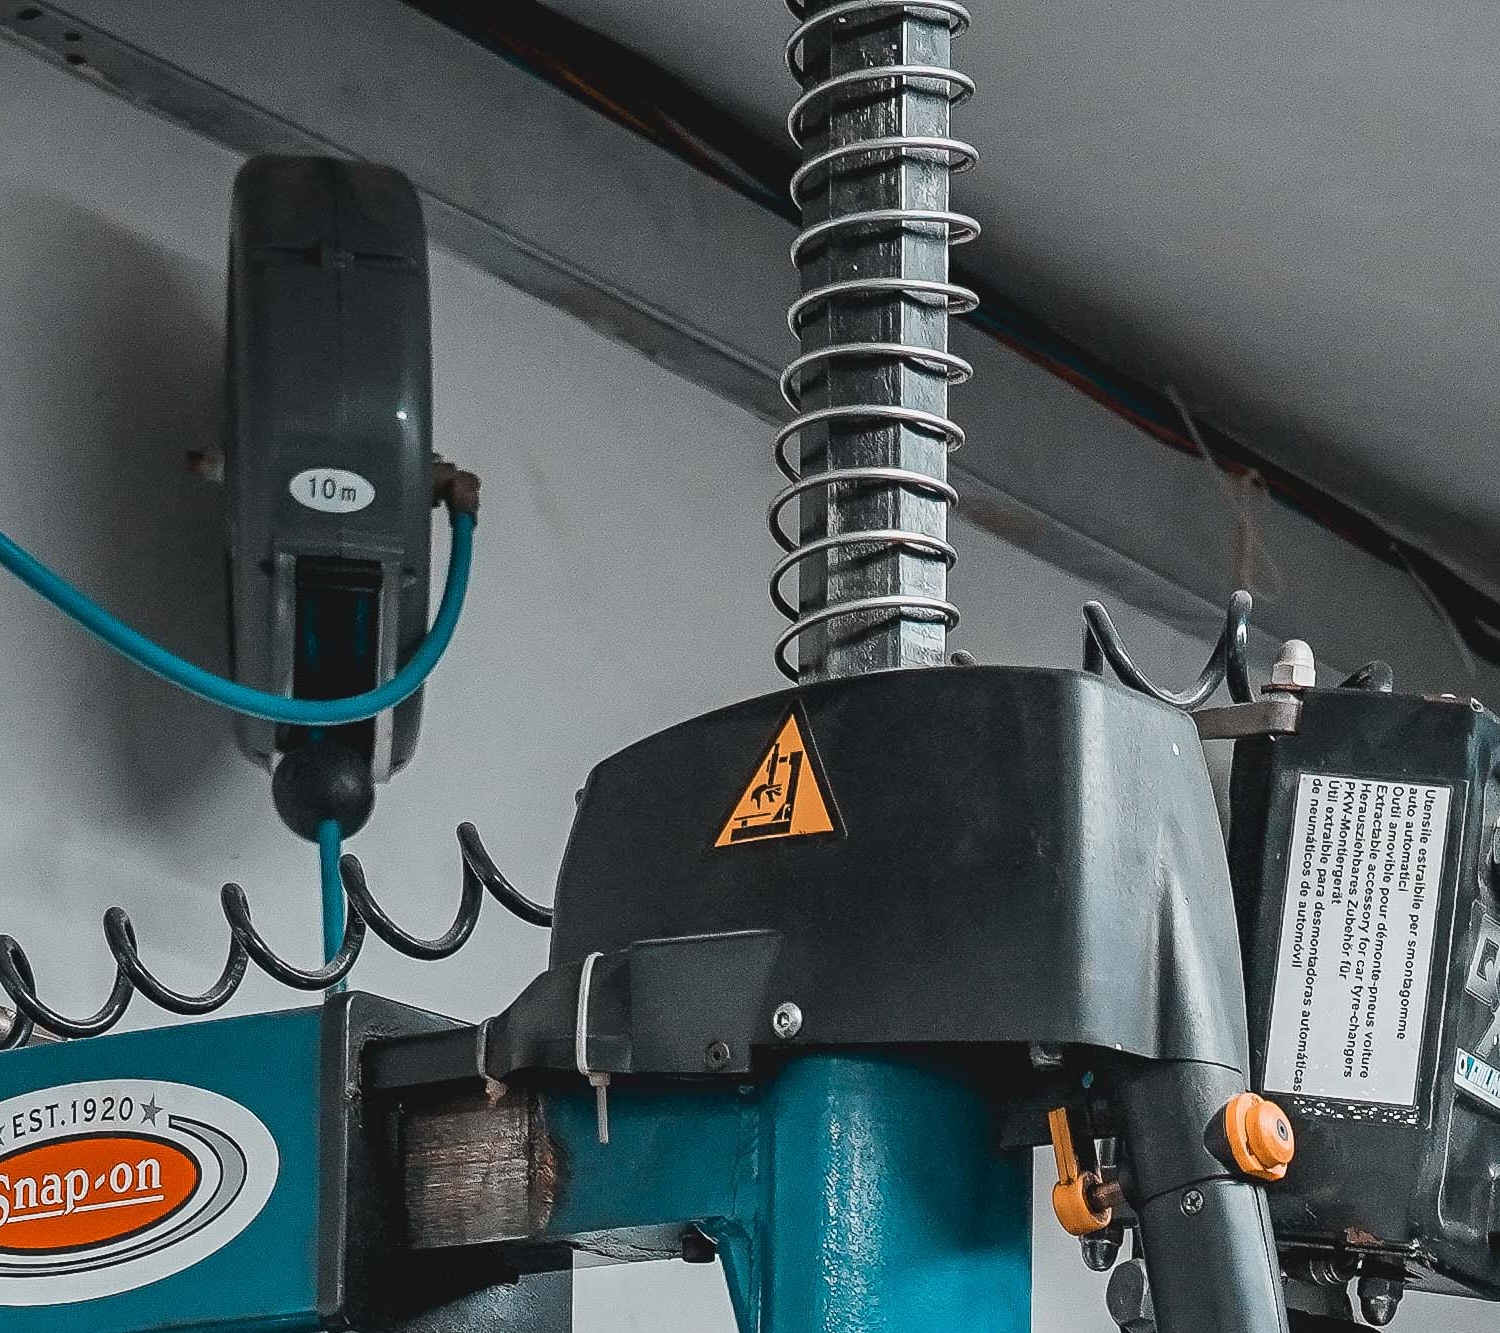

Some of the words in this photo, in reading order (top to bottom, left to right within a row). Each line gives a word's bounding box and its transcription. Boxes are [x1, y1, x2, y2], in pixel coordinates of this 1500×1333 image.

[1311, 778, 1323, 794] de
[1327, 780, 1341, 802] Útil
[1390, 786, 1405, 818] Outil
[1406, 787, 1418, 818] auto
[1301, 798, 1319, 877] neumáticos
[1319, 806, 1334, 864] extraíble
[1331, 781, 1356, 904] PKW-Montiergerät
[1348, 783, 1372, 896] Herausziehbares
[1369, 784, 1388, 860] Extractable
[1419, 789, 1436, 844] Utensile
[1382, 821, 1398, 883] amovible
[1398, 821, 1414, 892] automatici
[1411, 848, 1427, 910] estraibile
[1299, 880, 1311, 897] de
[1315, 868, 1327, 897] para
[1357, 863, 1376, 933] accessory
[1378, 887, 1390, 919] pour
[1291, 901, 1307, 968] automóvil
[1302, 901, 1325, 1006] desmontadoras
[1341, 899, 1359, 957] Zubehör
[1357, 937, 1371, 957] for
[1408, 913, 1419, 937] per
[1338, 960, 1352, 980] für
[1354, 959, 1365, 982] car
[1365, 922, 1388, 1027] démonte-pneus
[1396, 940, 1416, 1040] smontagomme
[1292, 1010, 1311, 1091] automáticas
[1343, 985, 1364, 1078] tyre-changers
[1359, 1031, 1373, 1078] voiture
